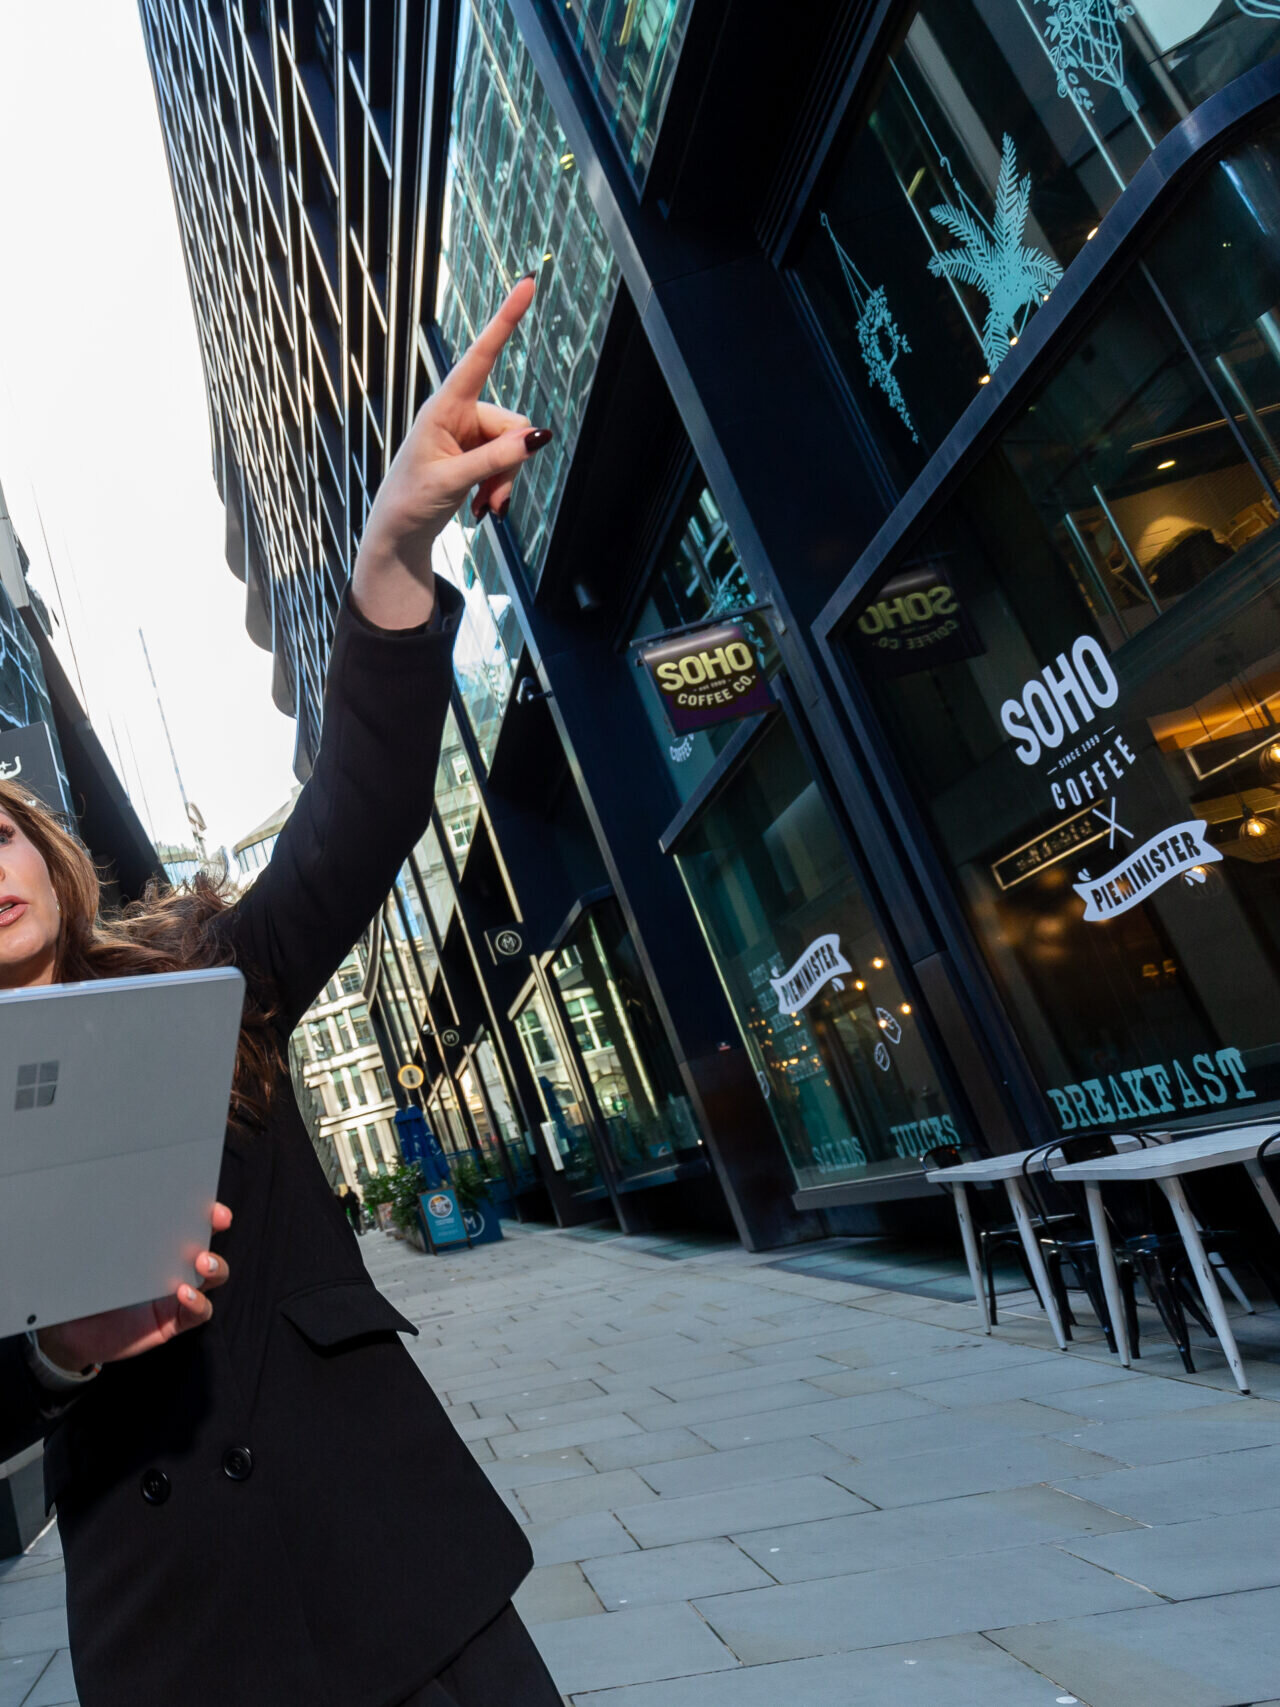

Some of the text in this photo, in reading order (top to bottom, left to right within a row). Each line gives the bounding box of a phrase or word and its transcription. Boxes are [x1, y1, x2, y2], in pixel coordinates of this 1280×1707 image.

[657, 642, 753, 691] SOHO
[678, 674, 756, 706] COFFEE CO.
[1000, 635, 1119, 765] SOHO
[1051, 735, 1136, 810] COFFEE
[1058, 734, 1100, 769] SINCE 1999
[1090, 831, 1202, 912] PIEMINISTER
[780, 943, 840, 1008] PIEMINISTER
[1047, 1047, 1257, 1130] BREAKFAST
[890, 1114, 961, 1159] JUICES
